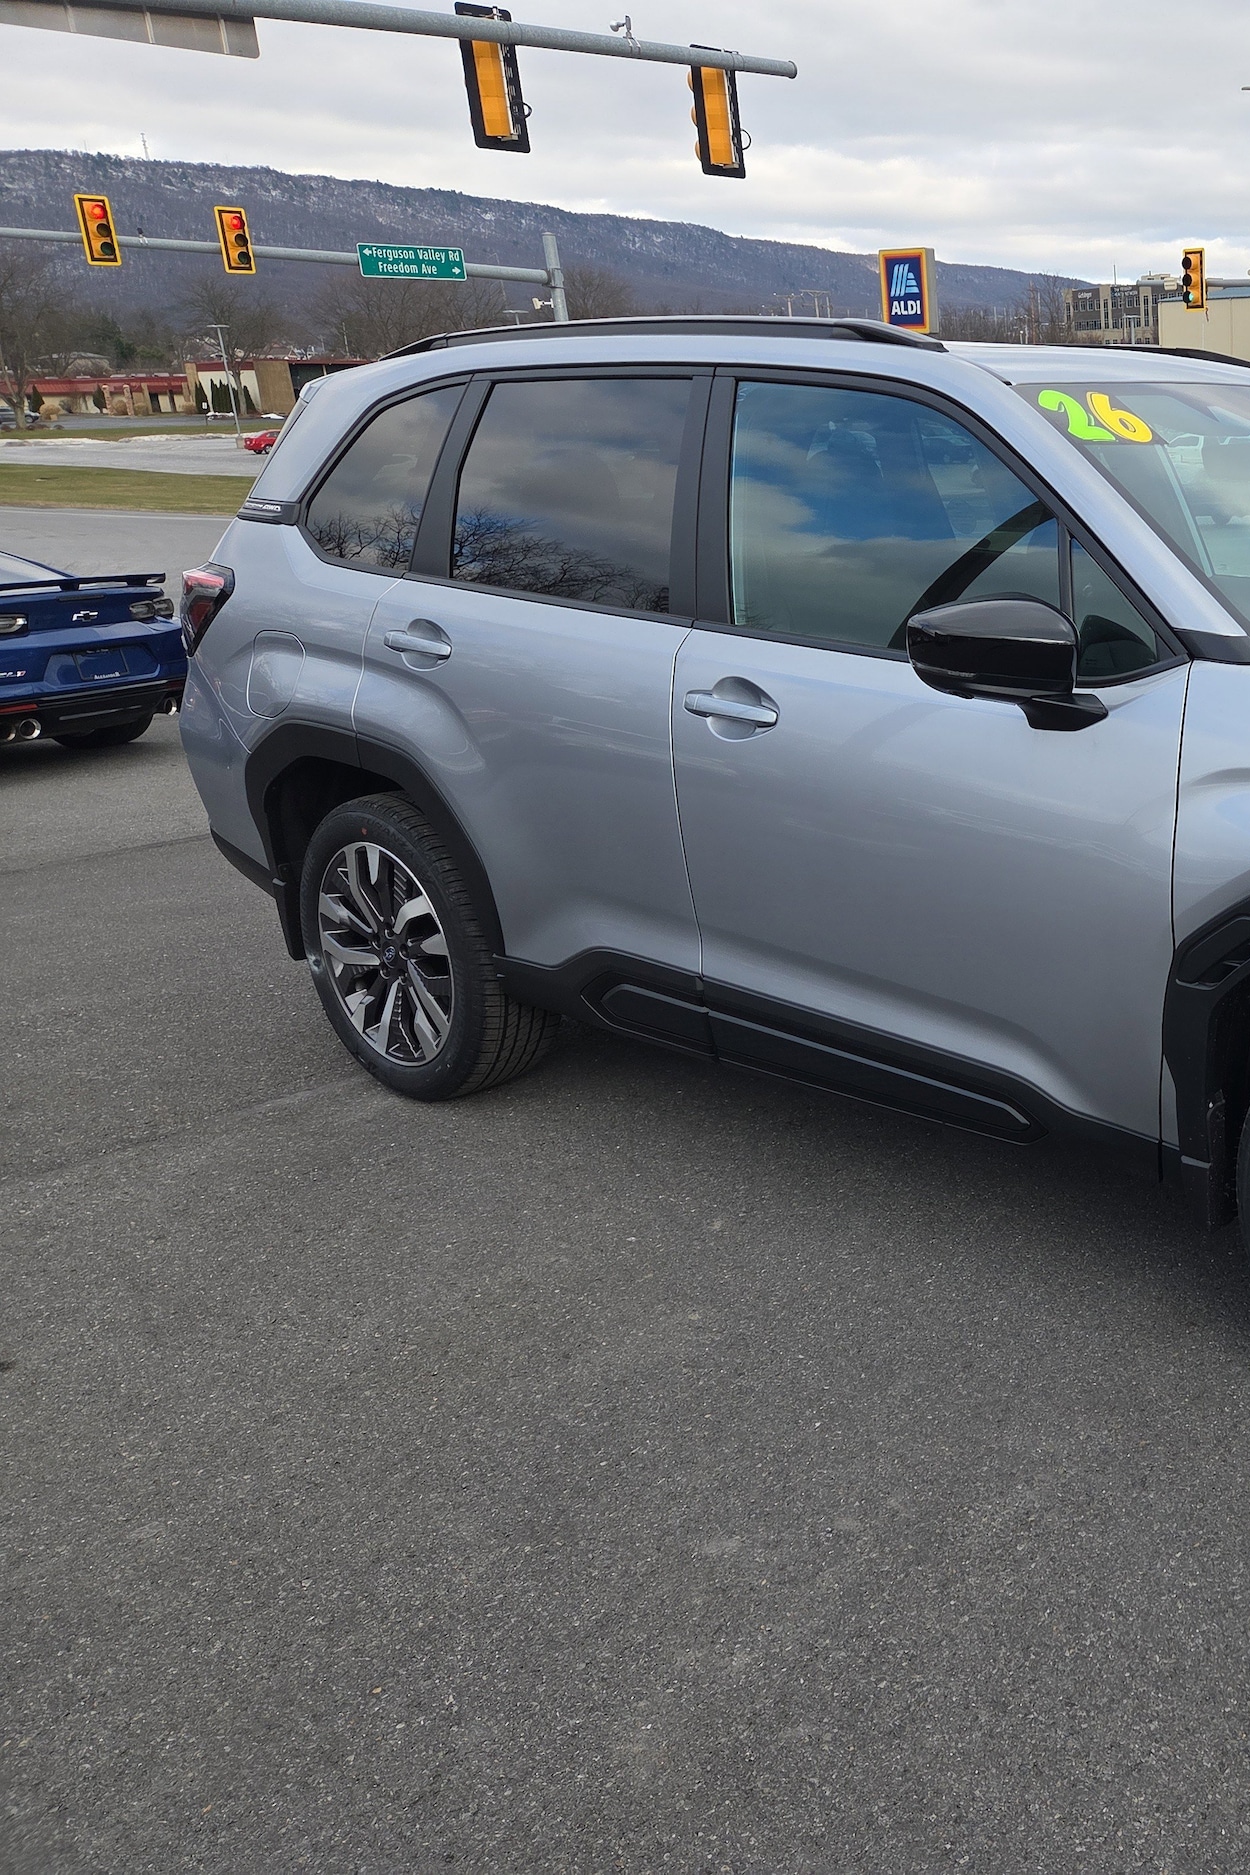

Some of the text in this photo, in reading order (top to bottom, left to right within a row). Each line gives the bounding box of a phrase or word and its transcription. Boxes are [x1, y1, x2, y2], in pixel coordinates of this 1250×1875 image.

[372, 247, 460, 263] Ferguson Valley Rd
[378, 262, 437, 274] Freedom Ave
[891, 300, 921, 315] ALDI
[1038, 390, 1152, 443] 26
